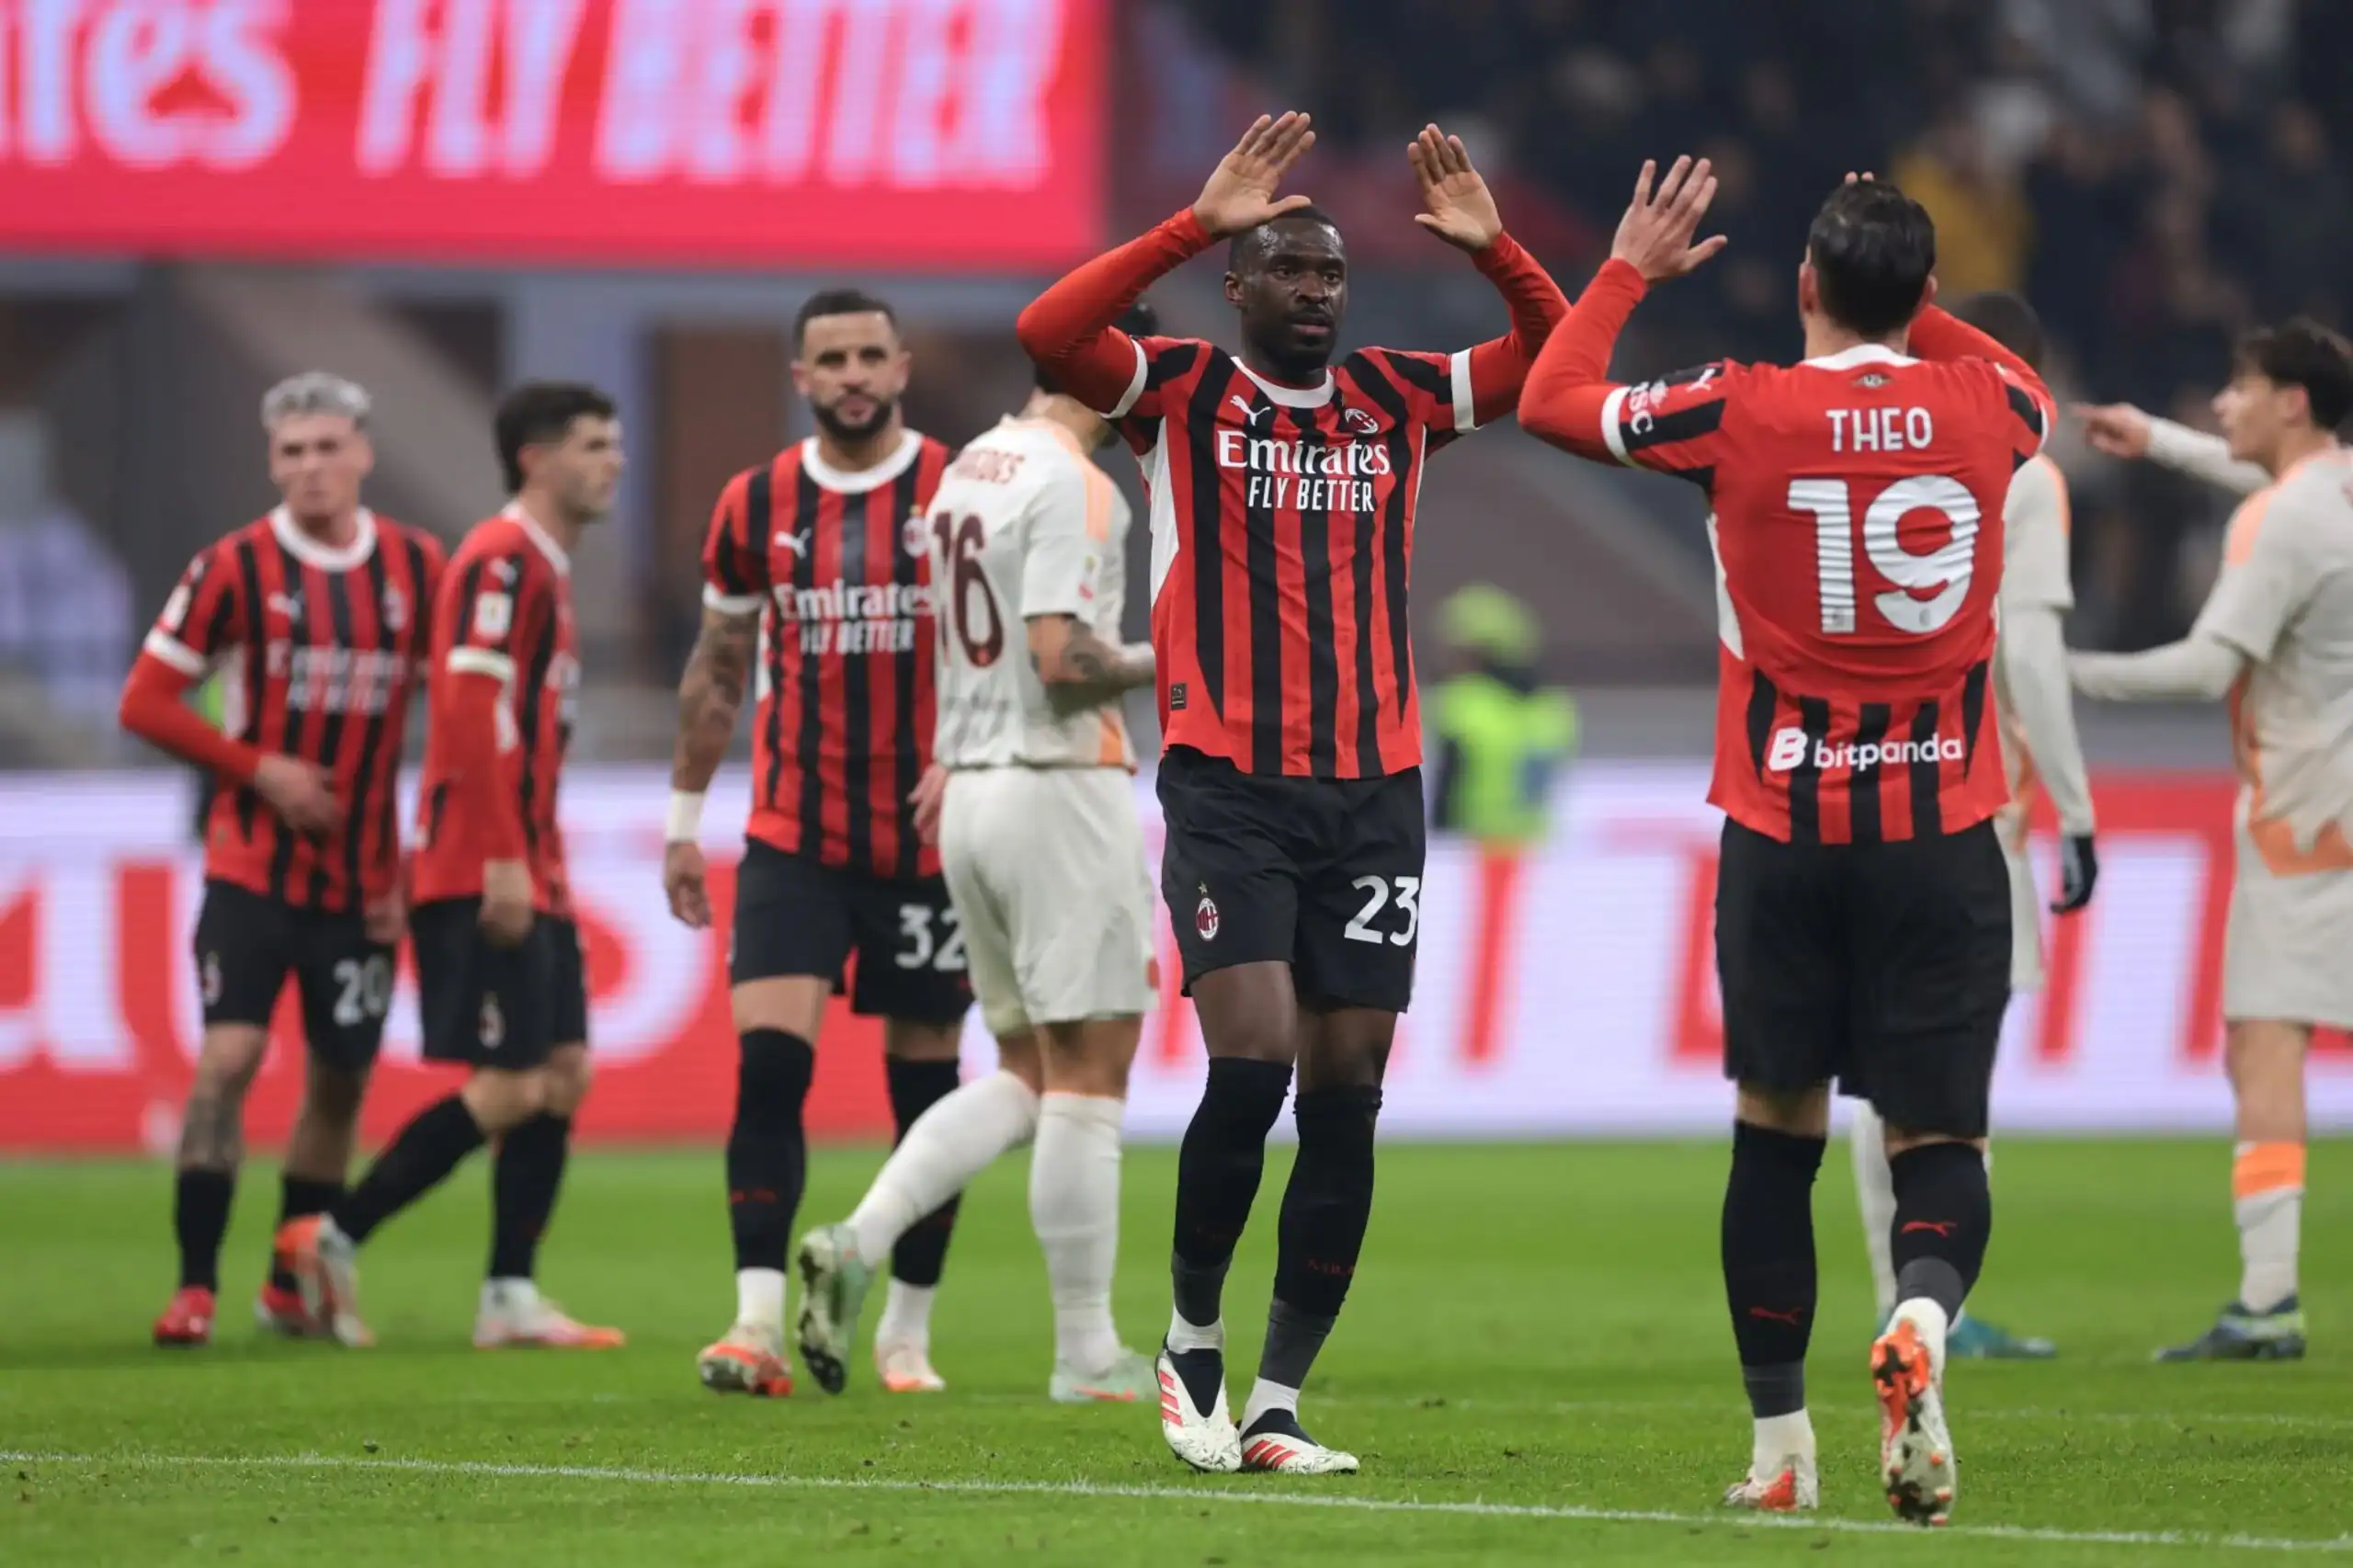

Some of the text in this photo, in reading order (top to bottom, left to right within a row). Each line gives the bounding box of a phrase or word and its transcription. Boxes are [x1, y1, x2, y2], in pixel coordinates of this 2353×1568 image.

[0, 0, 298, 171] tes
[1218, 430, 1391, 476] Emirates
[1825, 406, 1933, 451] THEO
[1248, 476, 1375, 512] FLY BETTER
[1788, 474, 1981, 635] 19
[934, 511, 1004, 668] 16
[1813, 733, 1962, 772] bitpanda
[894, 903, 966, 971] 32
[1344, 874, 1419, 947] 23
[333, 956, 390, 1027] 20
